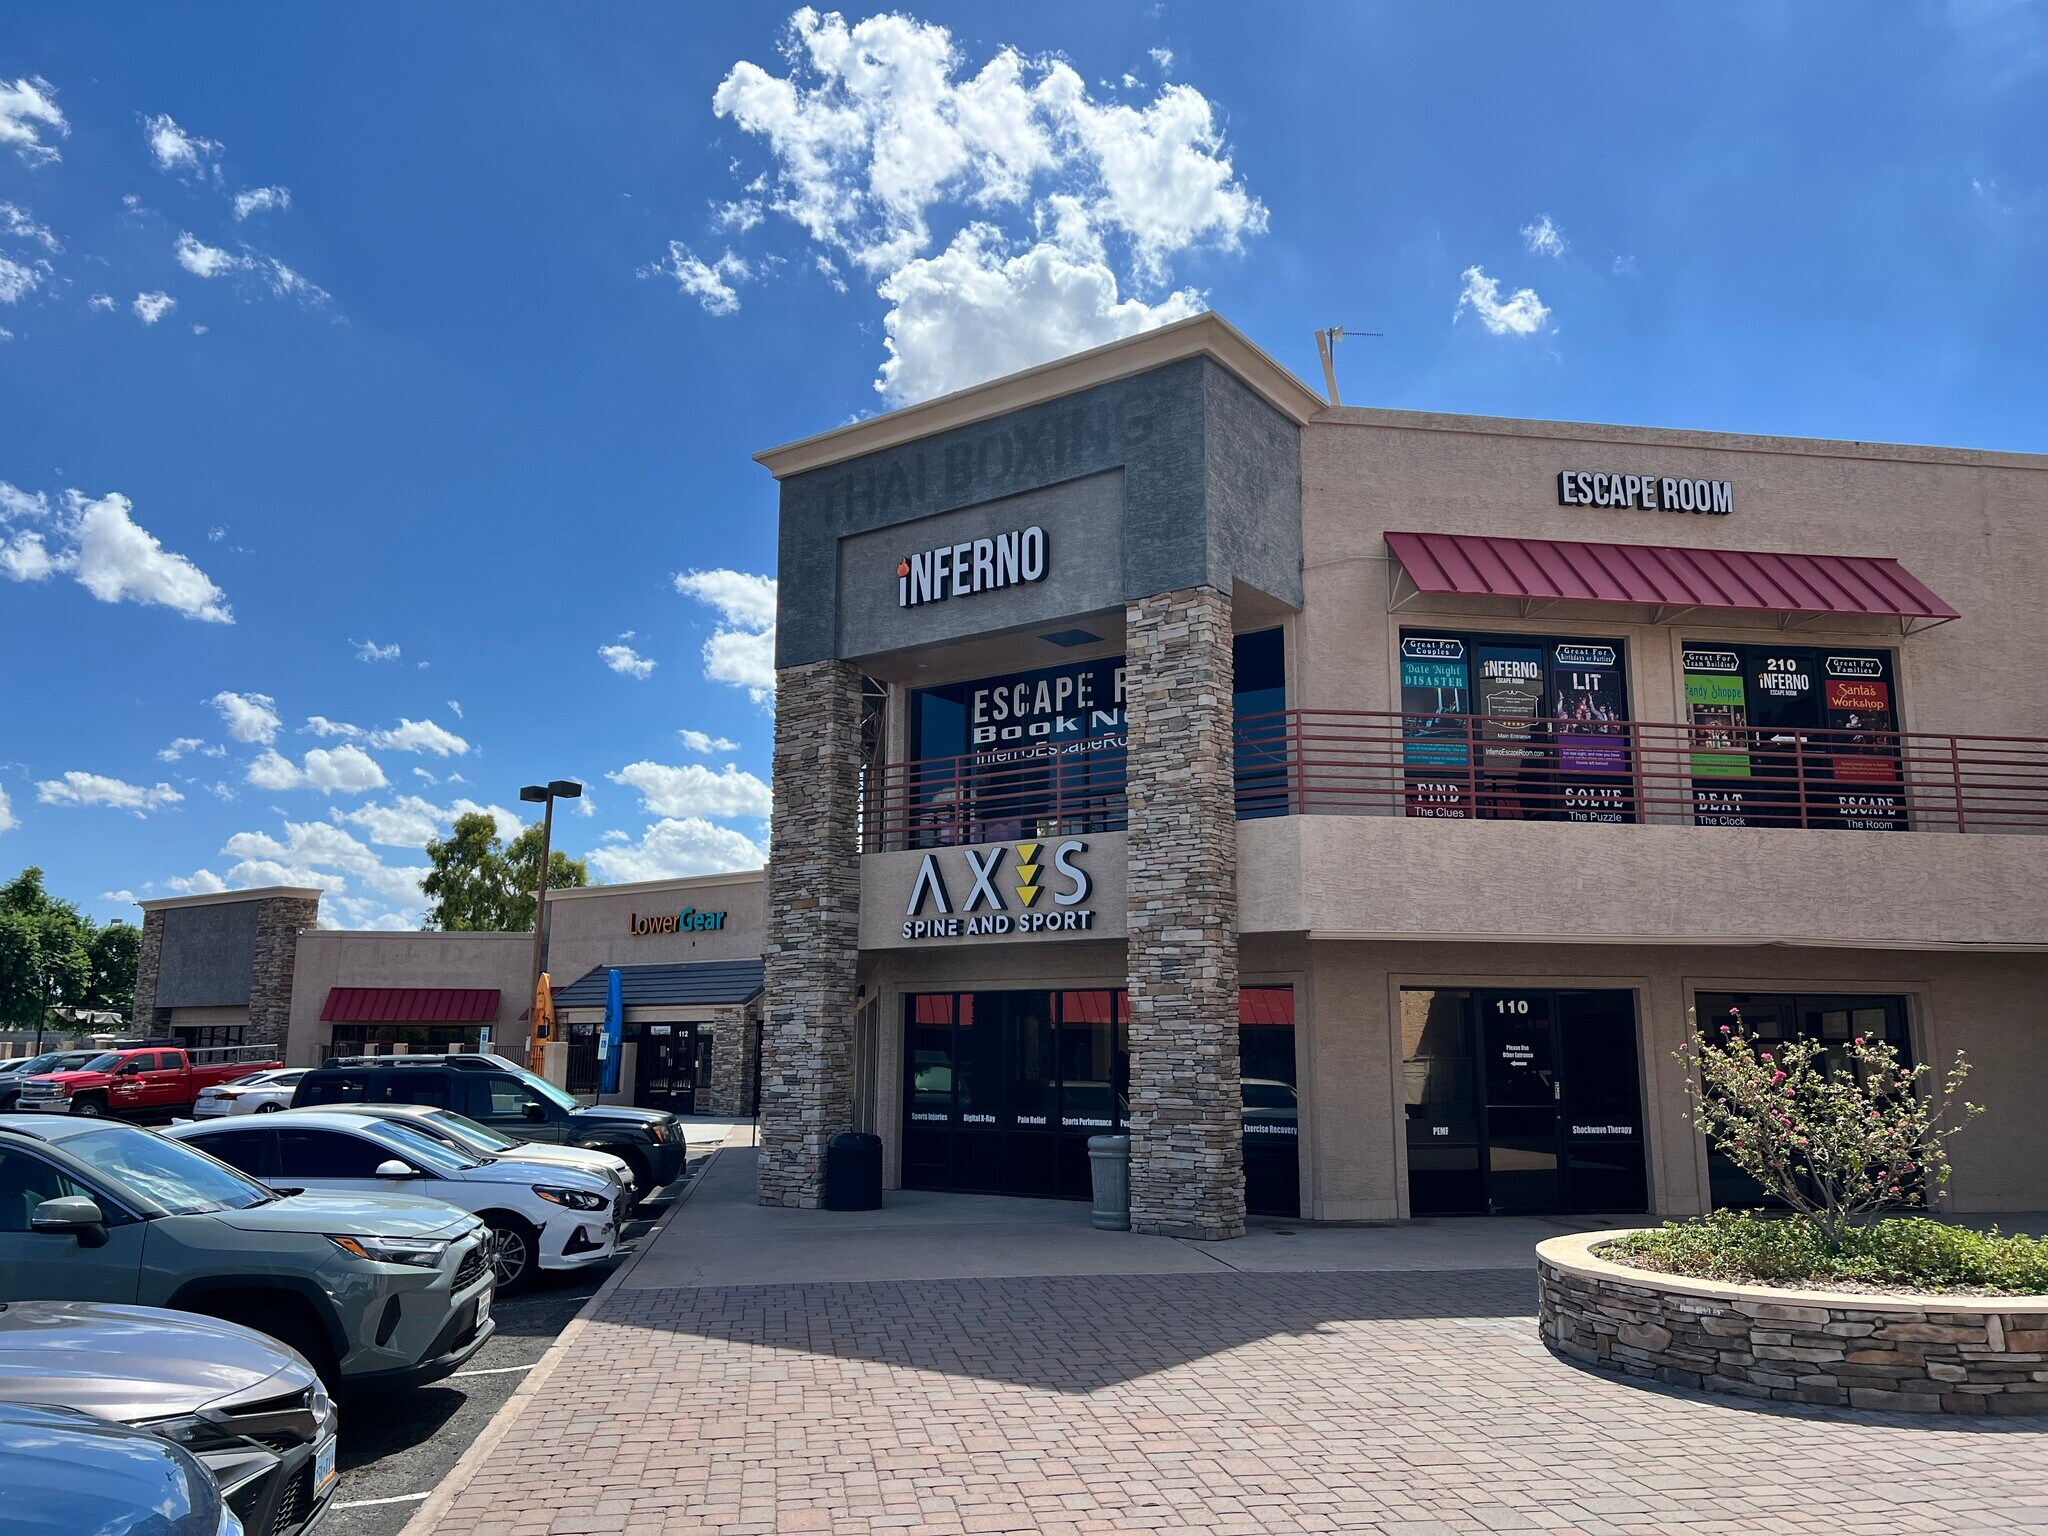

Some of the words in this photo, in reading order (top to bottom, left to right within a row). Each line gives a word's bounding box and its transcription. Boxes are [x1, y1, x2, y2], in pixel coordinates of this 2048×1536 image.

[1557, 470, 1656, 509] ESCAPE
[1657, 477, 1734, 515] ROOM
[1406, 664, 1430, 674] Date
[1433, 665, 1461, 677] Night
[1707, 661, 1734, 669] Building
[1767, 659, 1797, 671] 210
[1405, 676, 1462, 687] DISASTER
[1573, 673, 1601, 690] LIT
[1712, 684, 1742, 701] Shoppe
[1837, 684, 1876, 697] Santa's
[974, 672, 1094, 723] ESCAPE
[1832, 697, 1884, 710] Workshop
[974, 716, 1078, 744] Book
[1486, 748, 1545, 756] InfernoEscapeRoom.com
[1417, 784, 1460, 803] FIND
[1565, 788, 1623, 808] SOLVE
[1697, 793, 1743, 812] BEAT
[1838, 796, 1896, 816] ESCAPE
[1414, 807, 1434, 817] The
[1436, 807, 1465, 818] Clues
[1568, 811, 1589, 822] The
[1590, 812, 1622, 822] Puzzle
[1699, 815, 1717, 825] The
[1718, 816, 1746, 826] Clock
[1846, 820, 1865, 829] The
[1866, 820, 1893, 830] Room
[629, 906, 727, 936] LowerGear
[902, 918, 963, 940] SPINE
[966, 914, 1014, 936] AND
[1019, 910, 1095, 933] SPORT
[1496, 1000, 1528, 1014] 110
[678, 1030, 689, 1038] 112
[911, 1112, 927, 1120] Sports
[928, 1113, 948, 1121] Injuries
[963, 1114, 980, 1122] Digital
[981, 1114, 996, 1123] X-Ray
[1018, 1115, 1029, 1124] Pain
[1030, 1116, 1046, 1124] Relief
[1062, 1117, 1078, 1126] Sports
[1079, 1118, 1112, 1127] Performance
[1120, 1119, 1130, 1128] Pos
[1243, 1123, 1269, 1133] Exercise
[1269, 1125, 1297, 1135] Recovery
[1433, 1126, 1449, 1136] PEMF
[1572, 1125, 1606, 1134] Shockwave
[1607, 1125, 1632, 1135] Therapy
